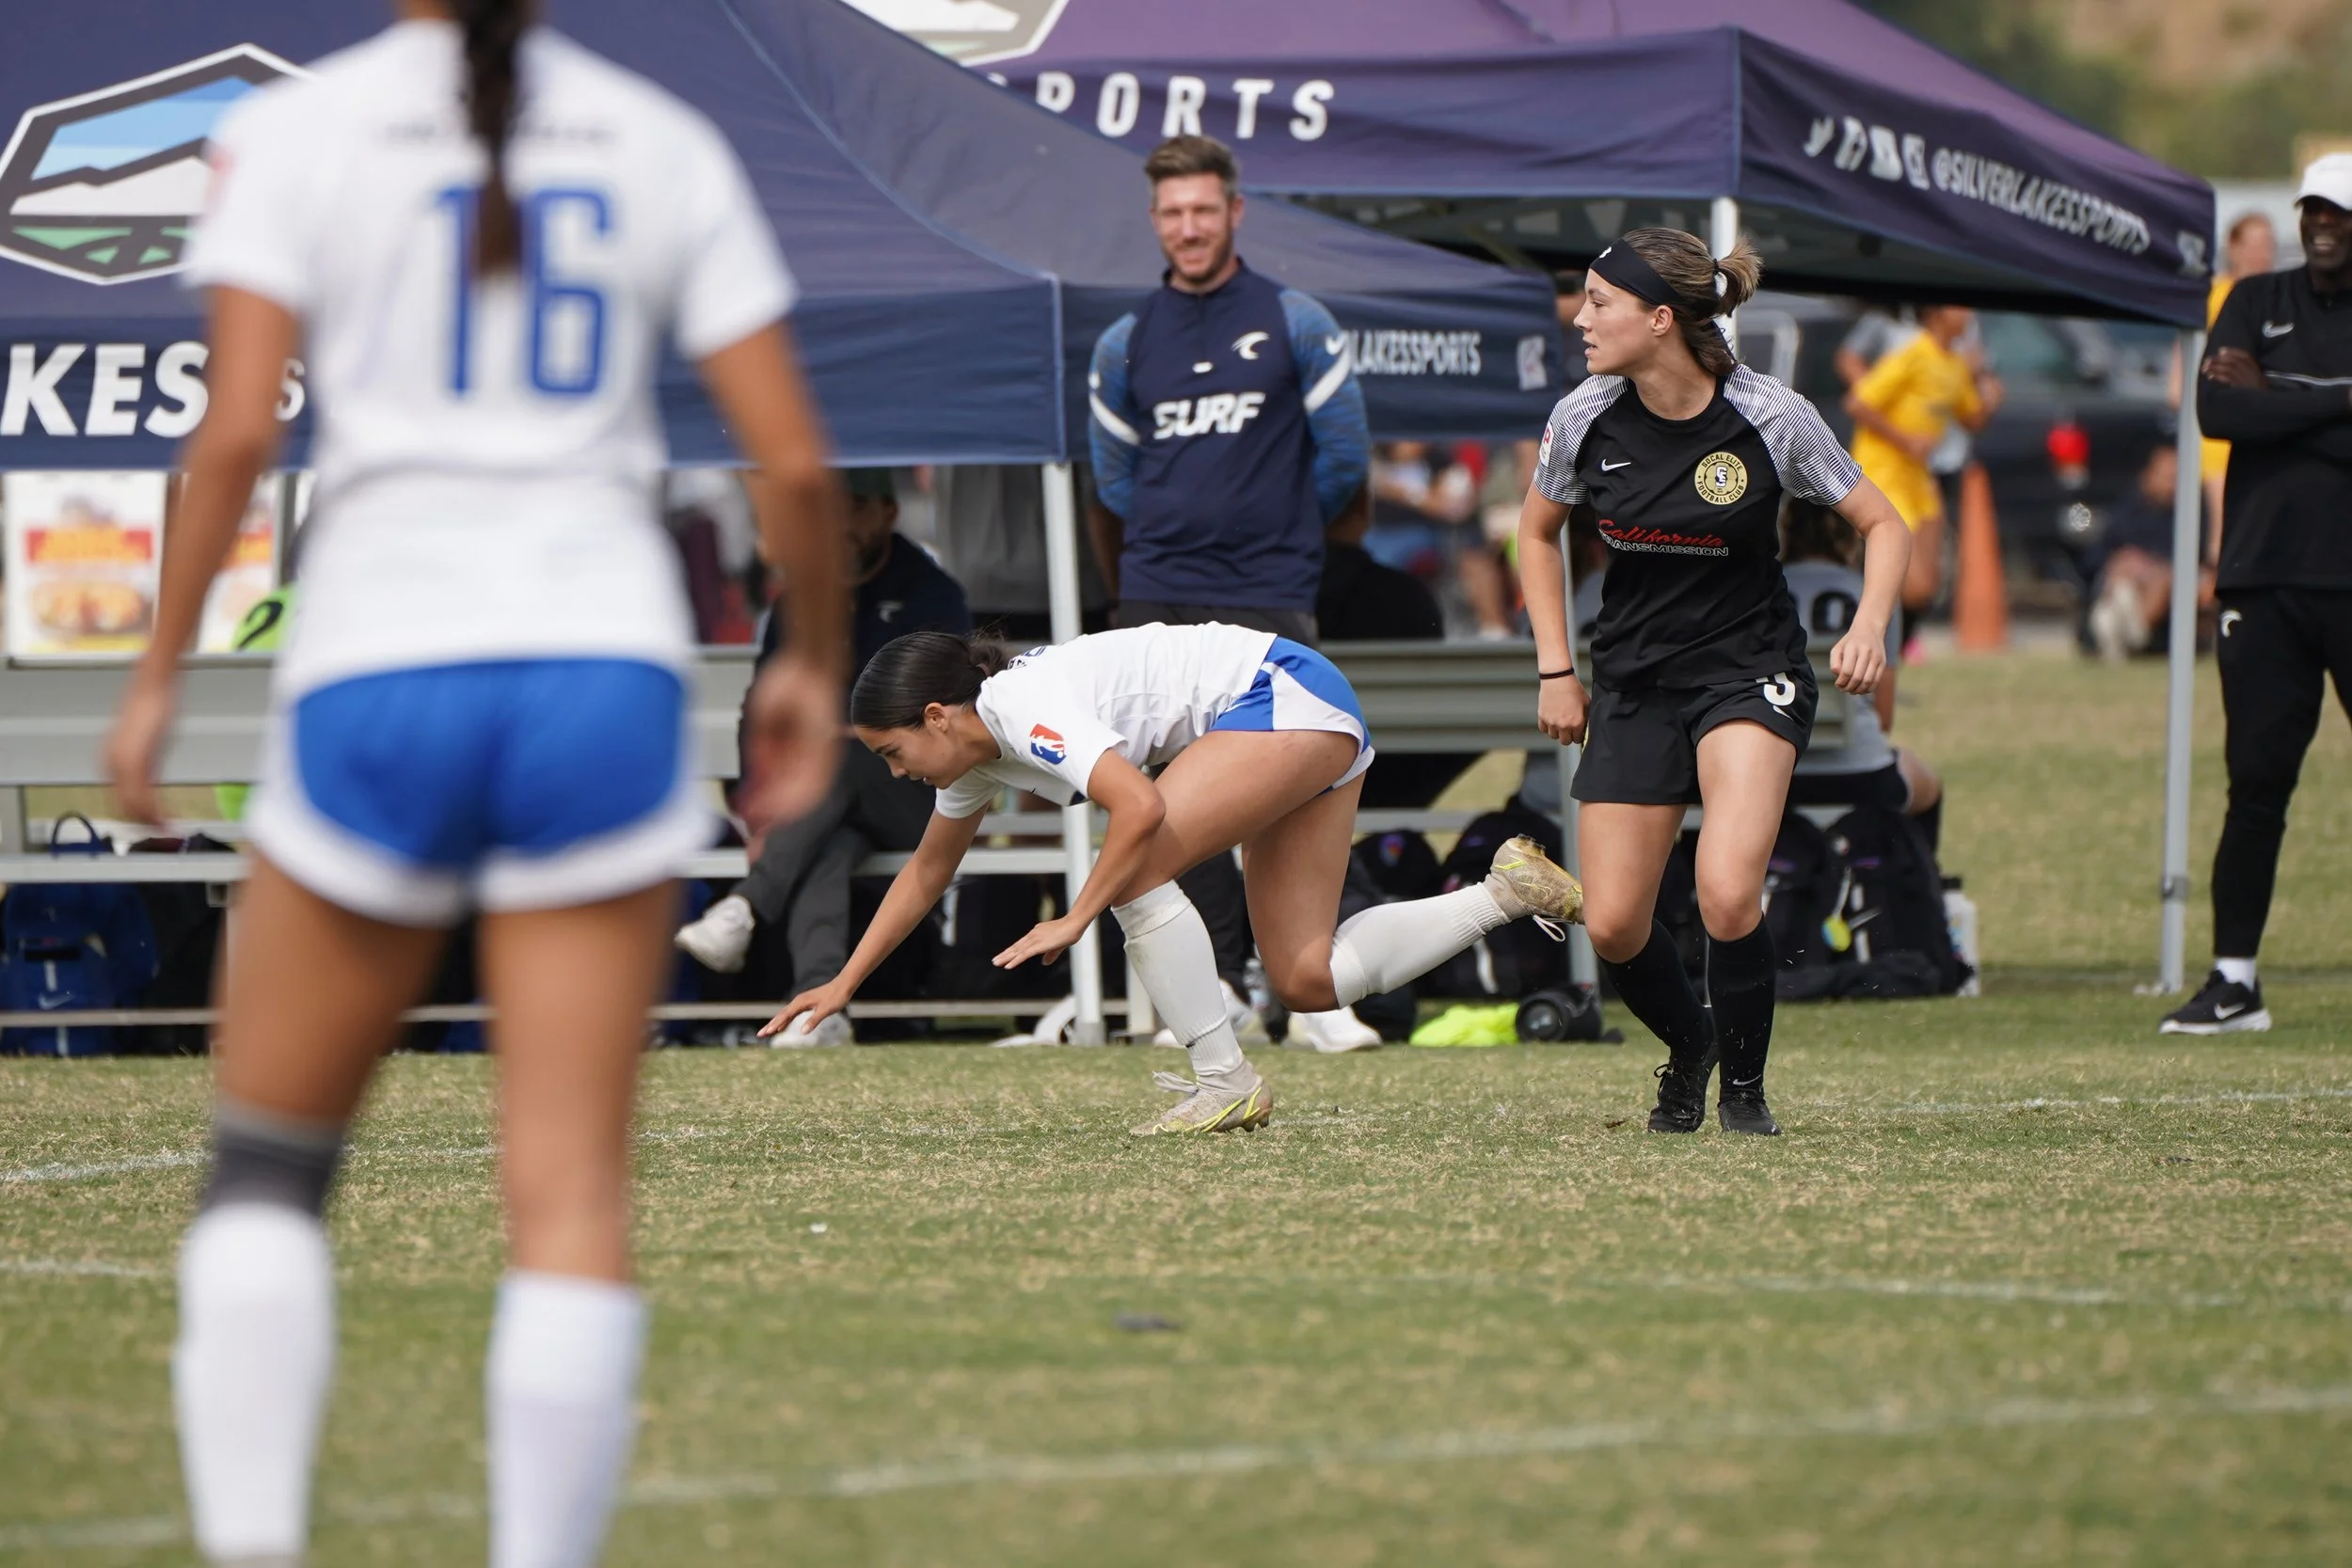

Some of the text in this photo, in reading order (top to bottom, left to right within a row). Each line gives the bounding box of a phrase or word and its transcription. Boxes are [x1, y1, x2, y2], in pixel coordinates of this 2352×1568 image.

[987, 71, 1335, 141] PORTS
[429, 184, 613, 397] 16
[0, 341, 210, 438] KES
[1152, 391, 1266, 440] SURF
[1702, 454, 1743, 470] SOCAL ELITE
[1697, 482, 1743, 502] FOOTBALL CLUB
